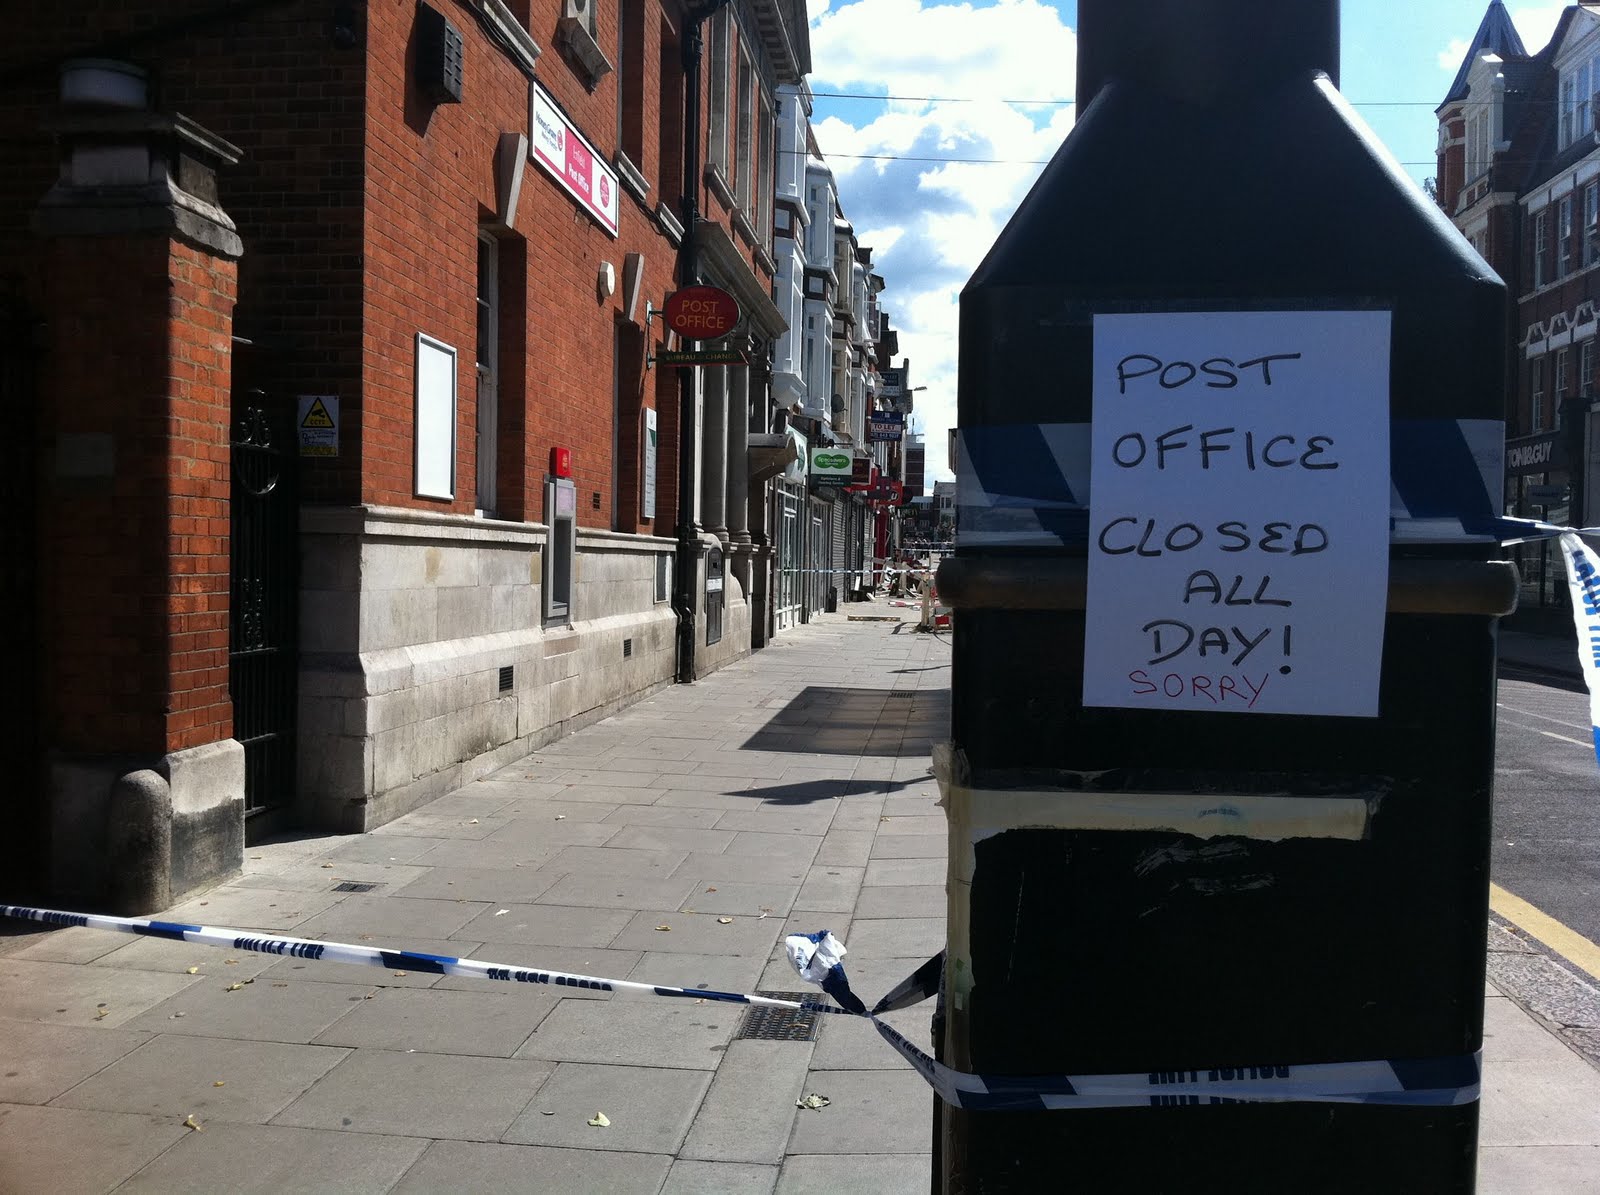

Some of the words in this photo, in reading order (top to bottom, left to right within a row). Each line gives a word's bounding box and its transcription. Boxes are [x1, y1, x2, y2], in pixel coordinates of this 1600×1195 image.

[568, 162, 578, 183] Post
[675, 314, 725, 329] OFFICE
[681, 300, 719, 313] POST
[1116, 352, 1301, 394] POST
[1112, 424, 1340, 471] OFFICE
[1507, 441, 1553, 468] TONI&GUY
[1097, 516, 1329, 556] CLOSED
[1183, 569, 1292, 607] ALL
[1142, 619, 1292, 675] DAY!
[1128, 669, 1269, 708] SORRY
